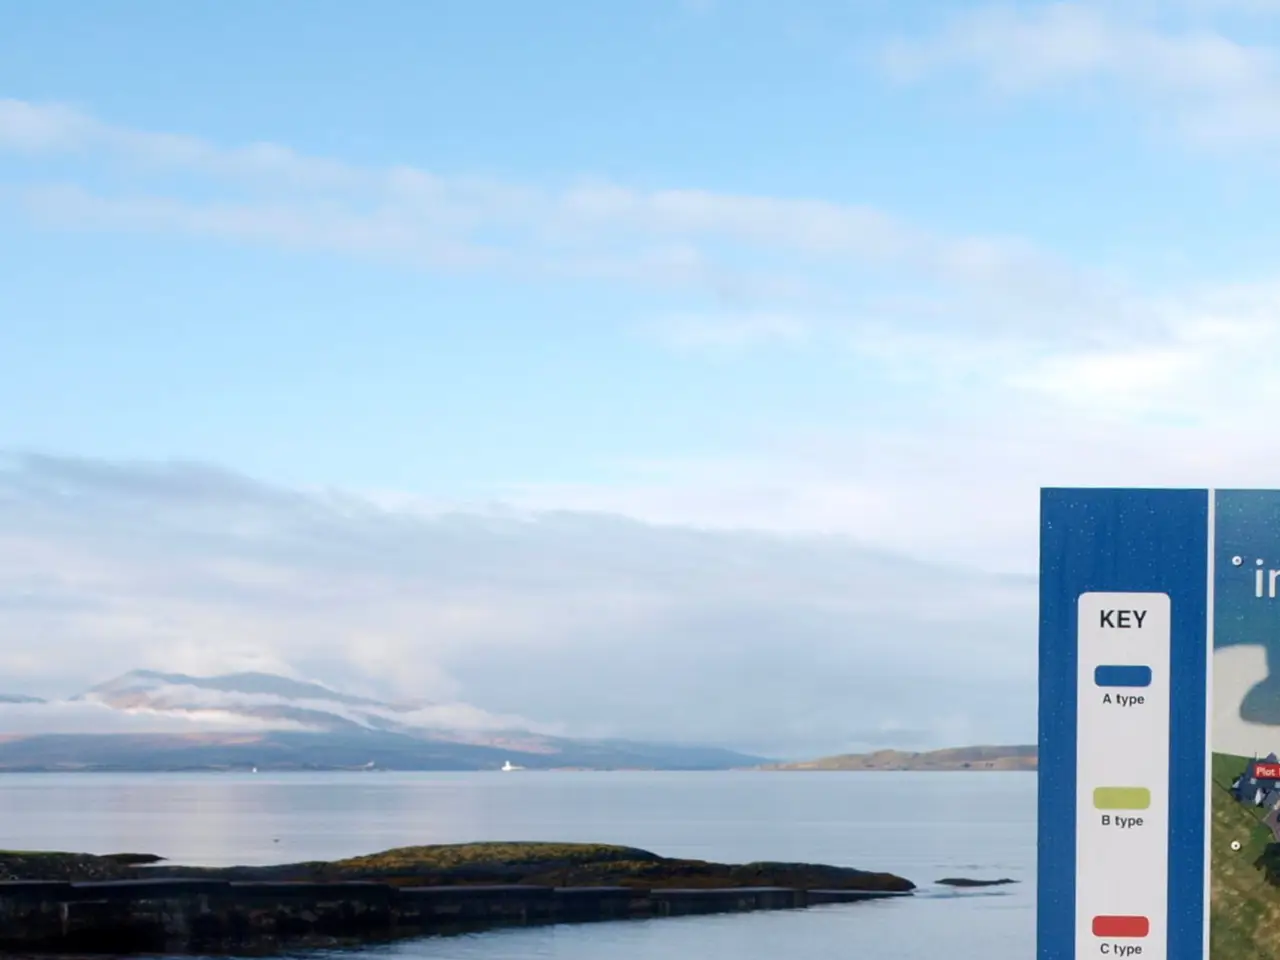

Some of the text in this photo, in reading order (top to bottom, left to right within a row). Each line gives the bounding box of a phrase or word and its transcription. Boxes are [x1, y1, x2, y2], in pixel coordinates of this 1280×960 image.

[1100, 609, 1147, 628] KEY
[1103, 693, 1145, 707] A type
[1256, 767, 1276, 777] Plot
[1102, 815, 1144, 830] B type
[1100, 943, 1142, 957] C type
